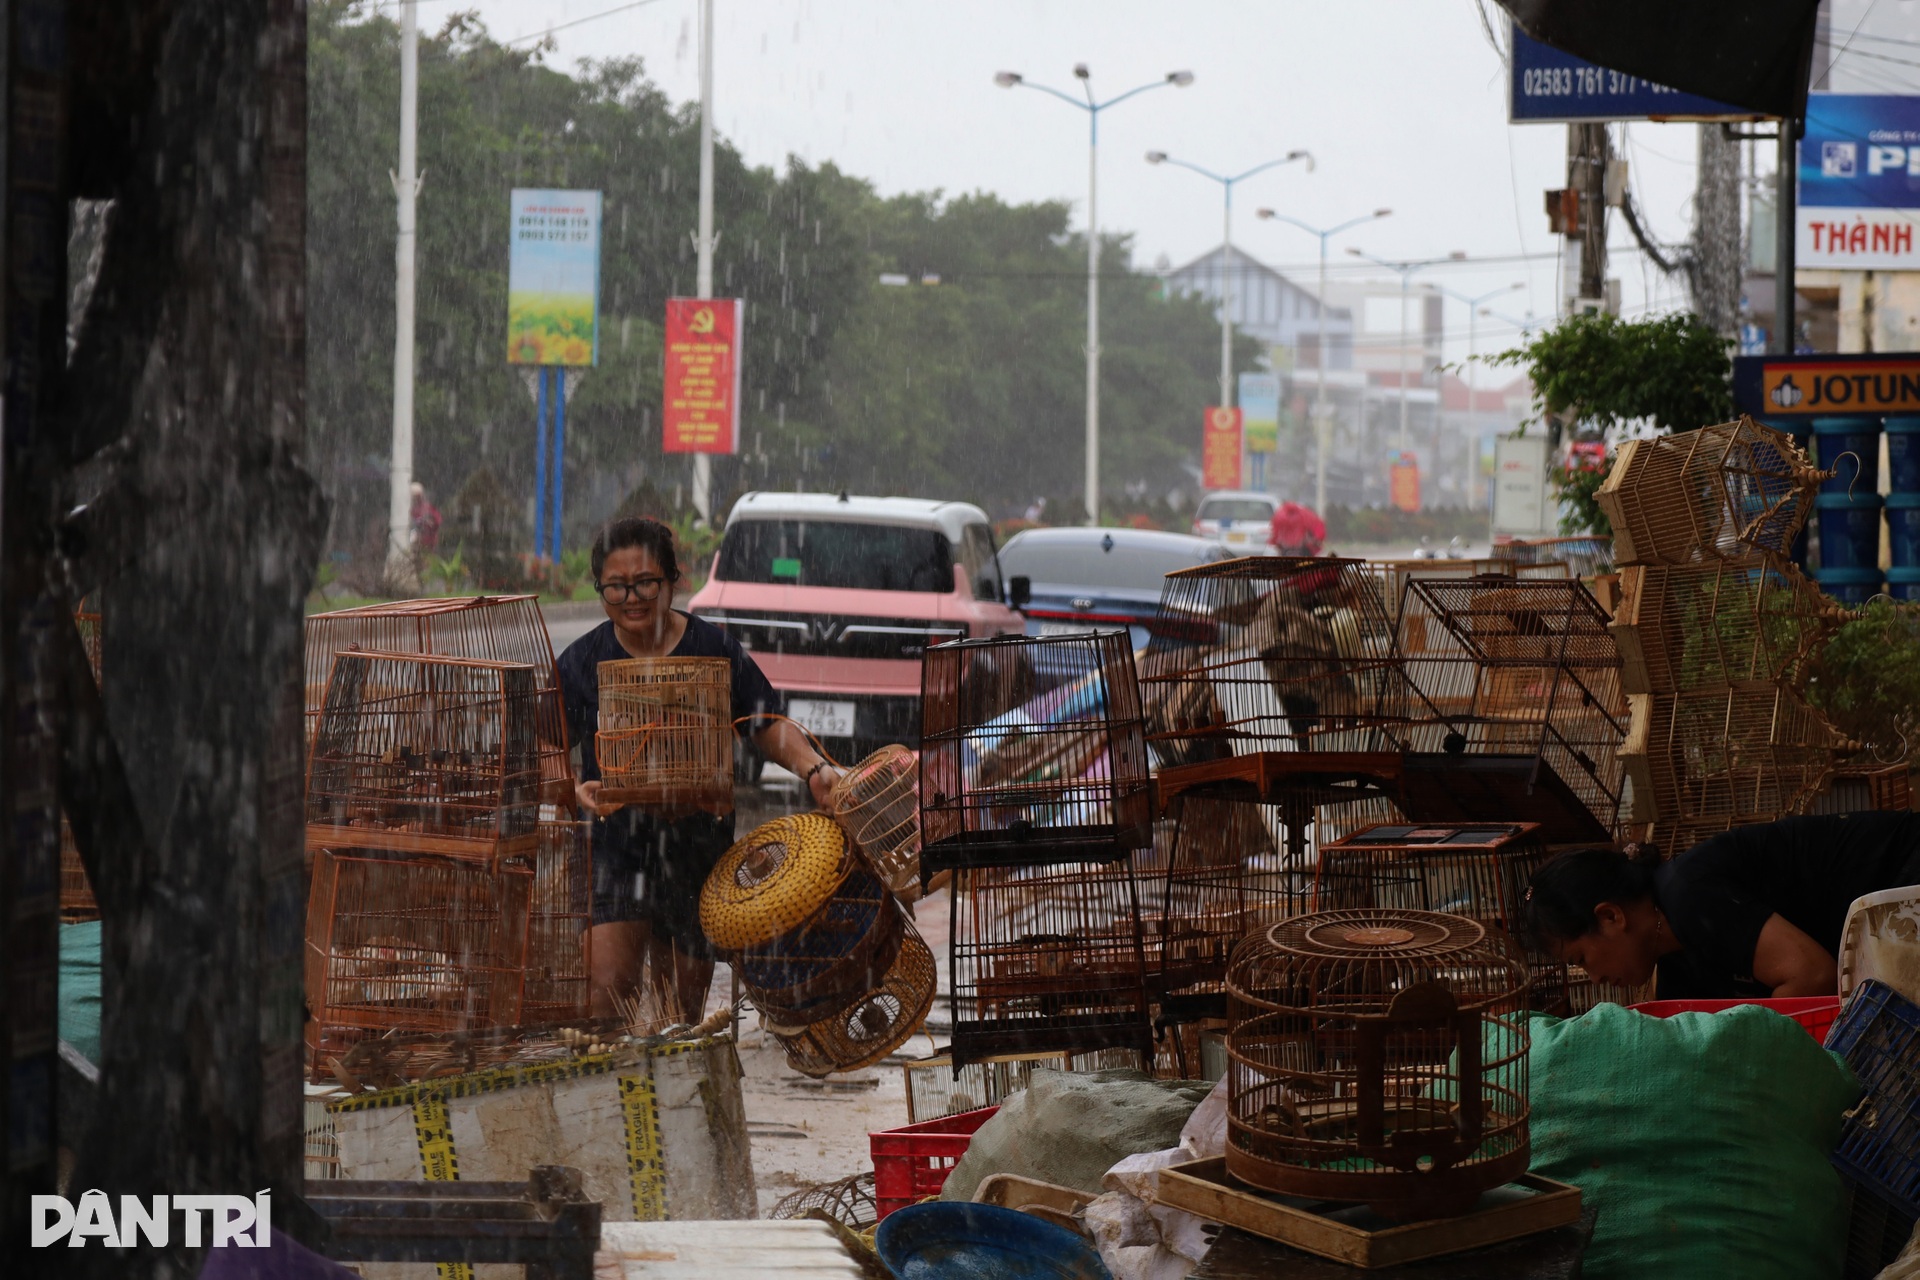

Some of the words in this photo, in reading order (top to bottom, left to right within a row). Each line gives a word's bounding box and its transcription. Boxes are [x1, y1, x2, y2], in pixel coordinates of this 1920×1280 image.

[1523, 67, 1573, 97] 02583
[1575, 66, 1604, 95] 761
[1808, 212, 1912, 255] THÀNH
[1808, 373, 1920, 406] JOTUN
[631, 1102, 645, 1151] FRAGILE
